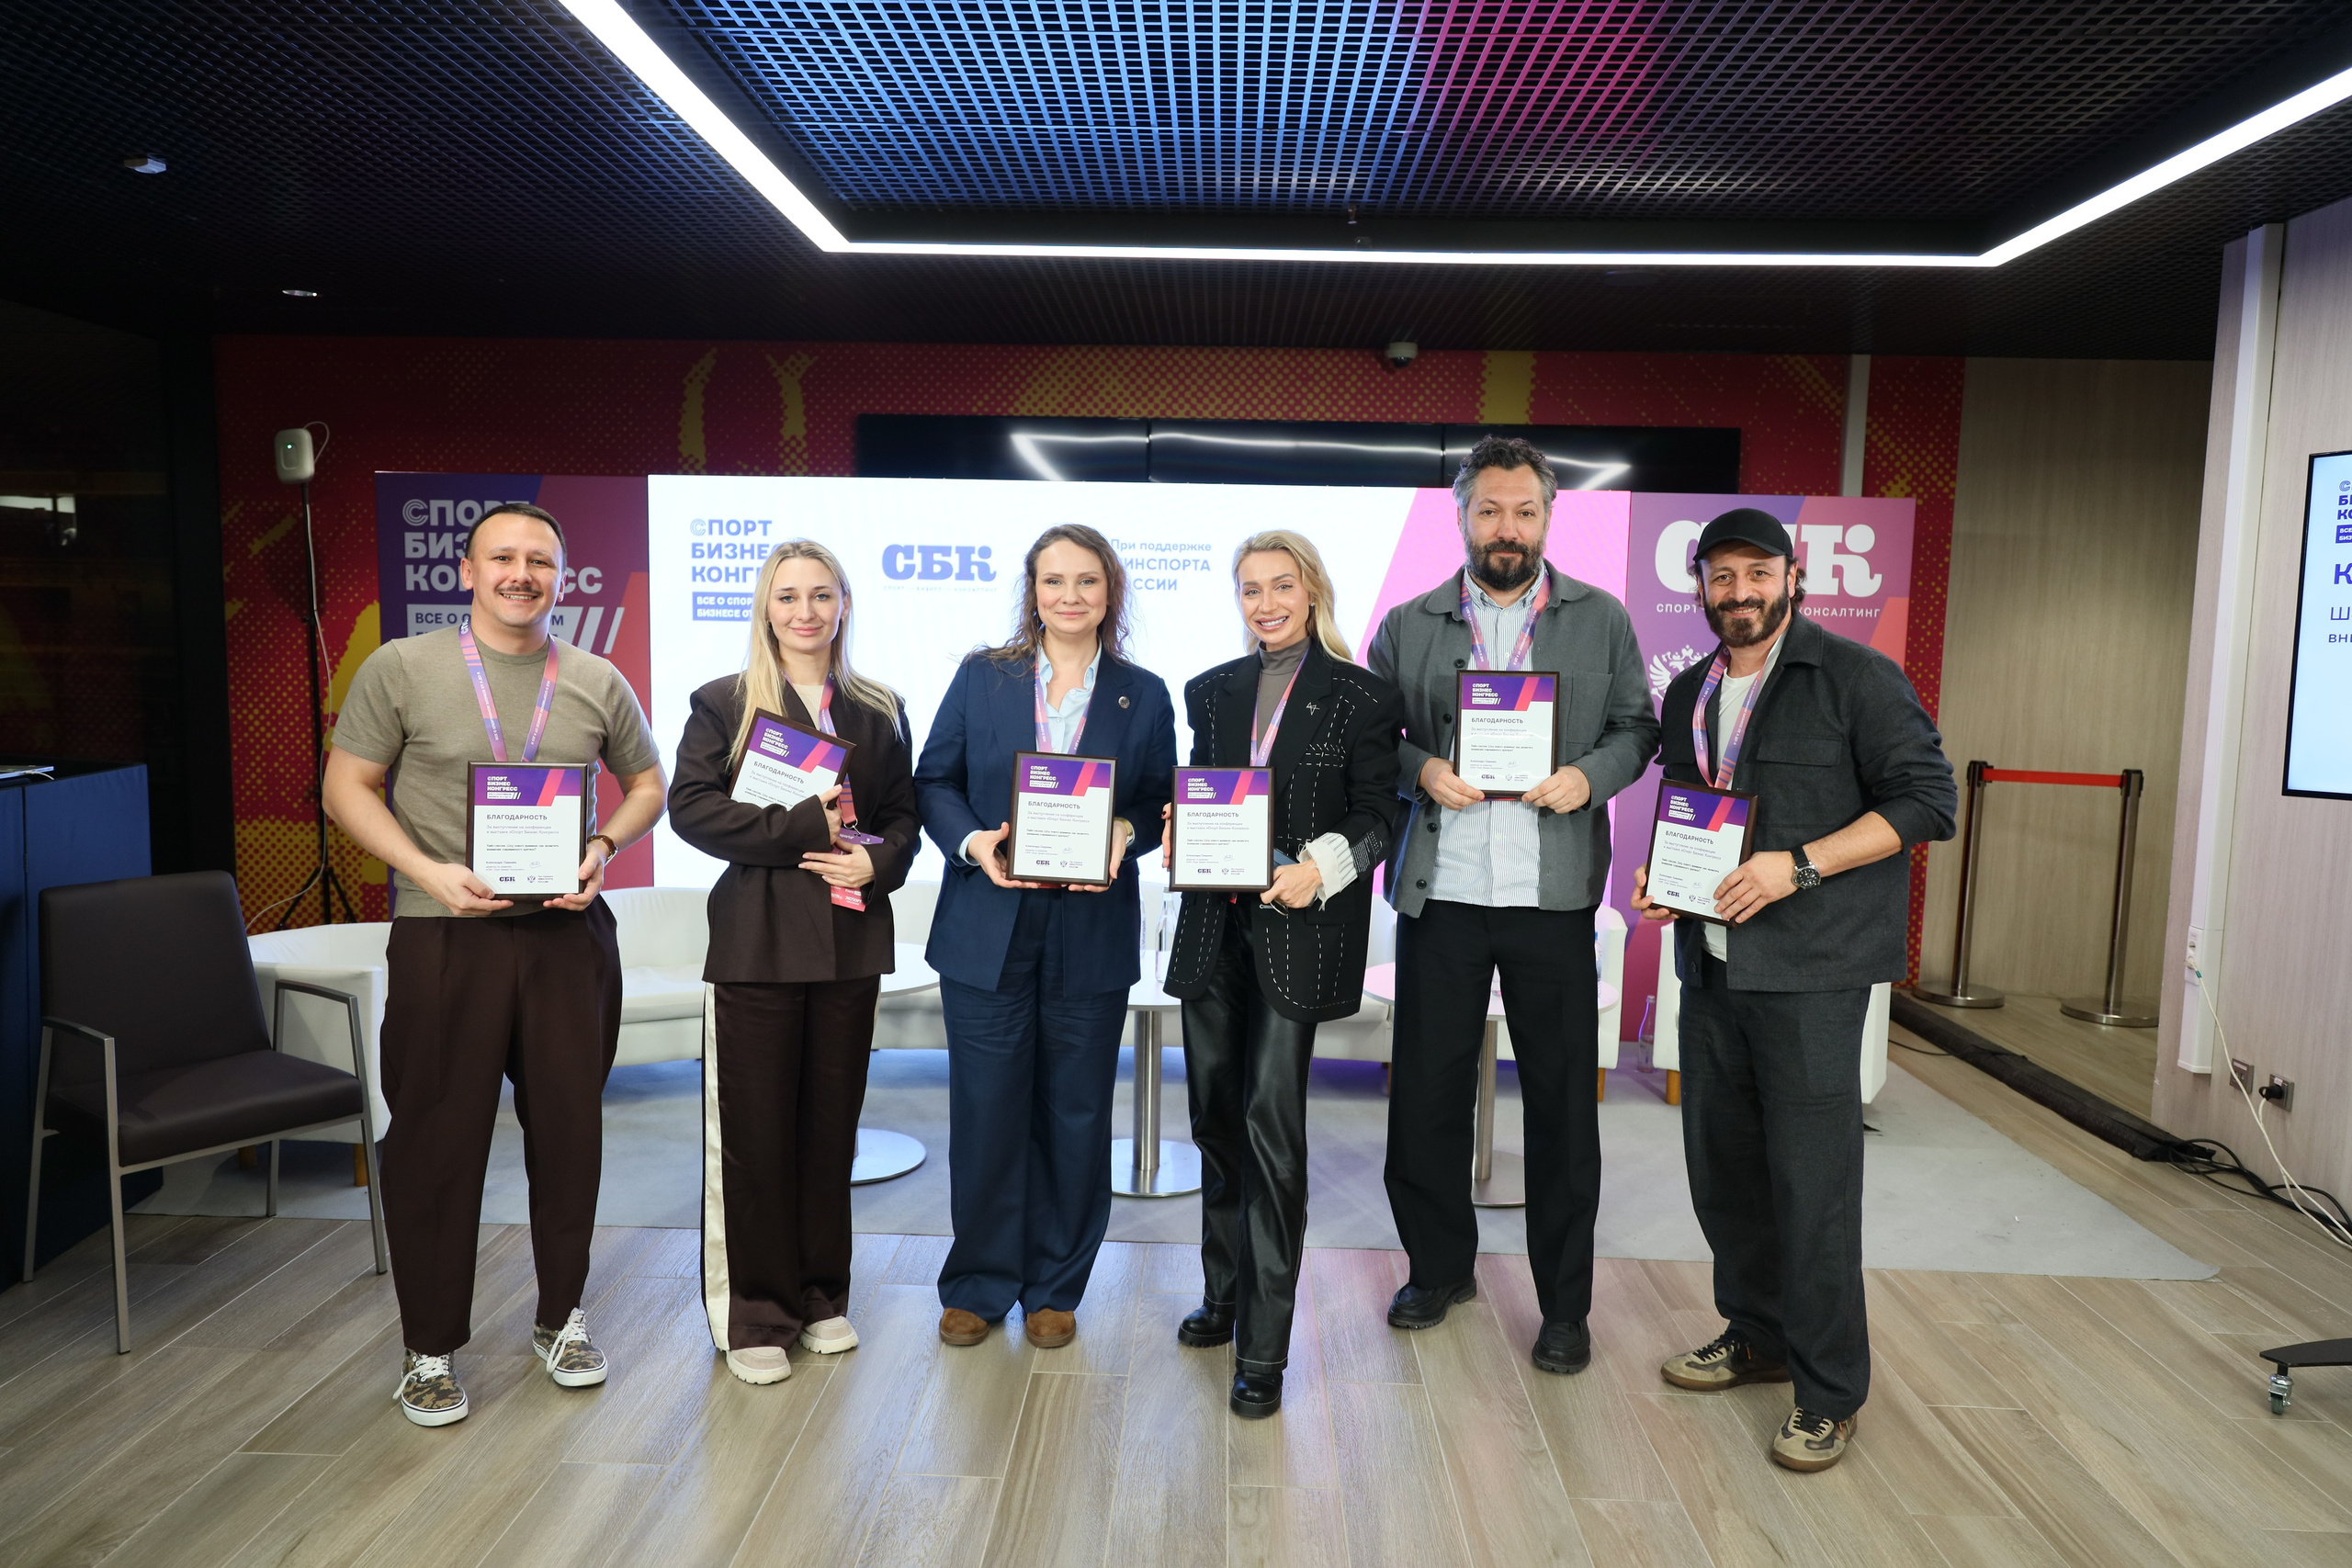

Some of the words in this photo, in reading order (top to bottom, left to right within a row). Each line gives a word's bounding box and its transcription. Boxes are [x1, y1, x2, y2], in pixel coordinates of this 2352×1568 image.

[402, 499, 530, 526] СПО
[690, 518, 772, 536] СПОРТ
[692, 542, 779, 559] БИЗНЕ
[1111, 538, 1136, 552] При
[1140, 543, 1211, 553] поддержке
[882, 544, 997, 581] СБК
[1121, 558, 1211, 571] ИНСПОРТА
[1655, 520, 1883, 597] СК
[692, 566, 761, 582] КОНГ
[1133, 578, 1178, 591] ССИИ
[696, 596, 715, 605] ВСЕ
[717, 597, 725, 605] О
[696, 609, 741, 618] БИЗНЕСЕ
[1657, 604, 1697, 614] СПОРТ
[415, 613, 443, 624] ВСЕ
[447, 613, 458, 624] О
[763, 733, 784, 743] БИЗНЕС
[765, 728, 783, 737] СПОРТ
[763, 737, 788, 750] КОНГРЕСС
[753, 761, 805, 784] БЛАГОДАРНОСТЬ
[1028, 801, 1080, 809] БЛАГОДАРНОСТЬ
[1669, 805, 1694, 813] КОНГРЕСС
[1666, 830, 1714, 845] БЛАГОДАРНОСТЬ
